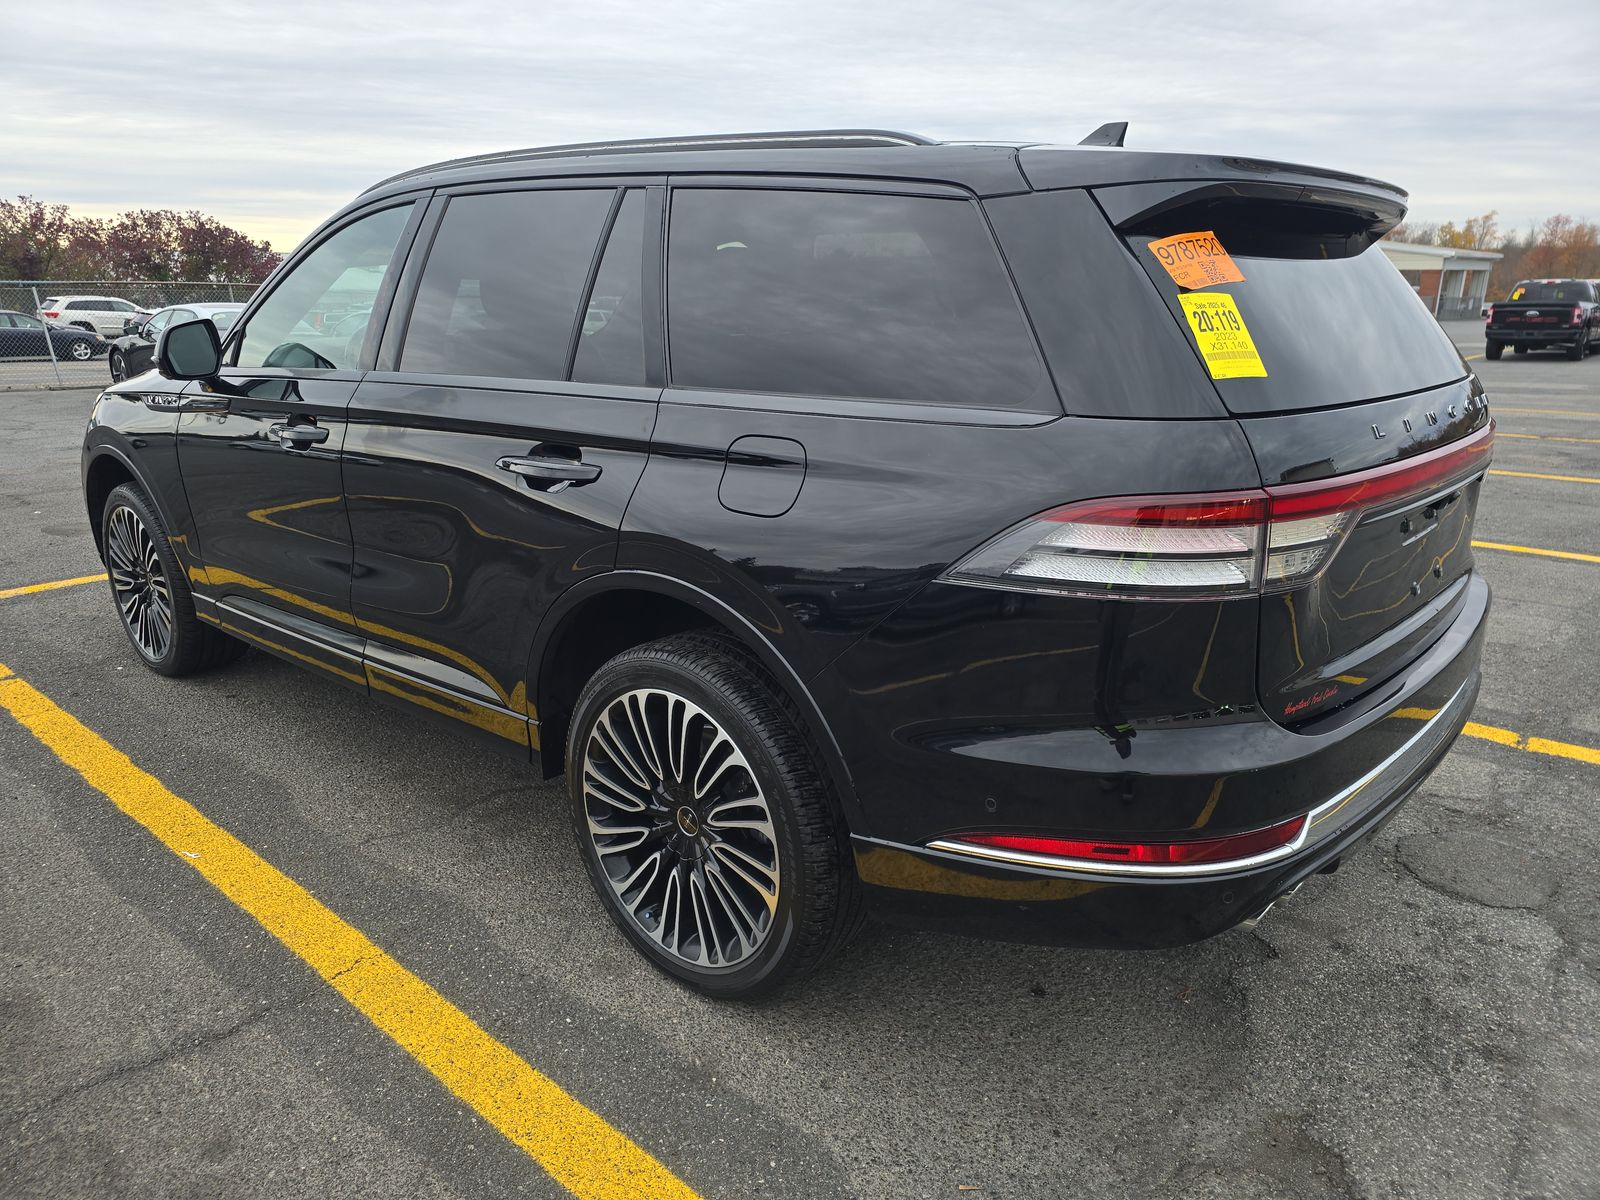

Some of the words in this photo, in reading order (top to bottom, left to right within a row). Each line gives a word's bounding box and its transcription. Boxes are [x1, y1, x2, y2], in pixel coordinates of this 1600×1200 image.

[1156, 237, 1226, 266] 9787520
[1173, 271, 1191, 281] FCR
[1192, 310, 1241, 333] 20:119
[1213, 332, 1238, 341] 2023
